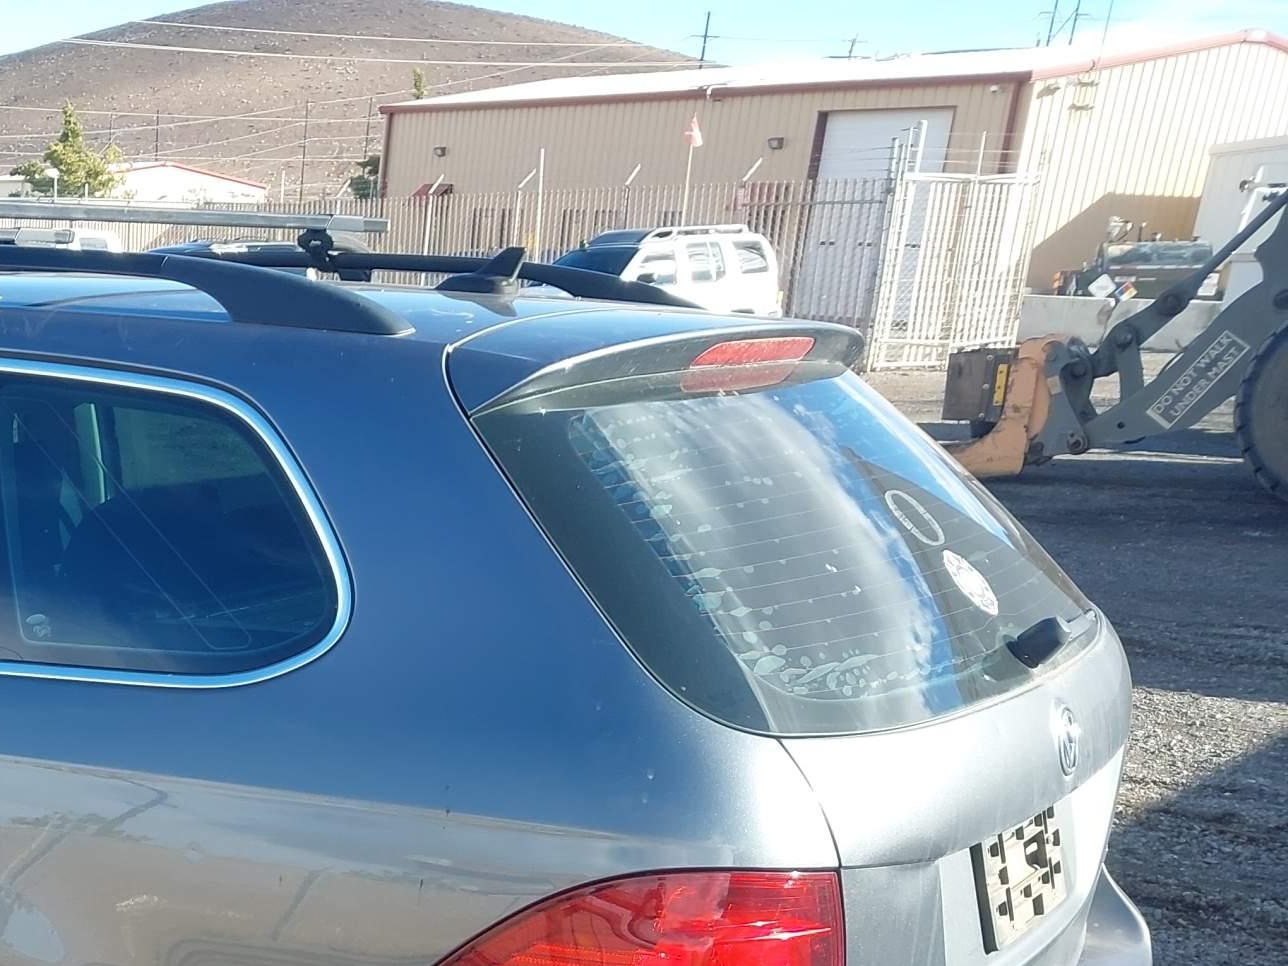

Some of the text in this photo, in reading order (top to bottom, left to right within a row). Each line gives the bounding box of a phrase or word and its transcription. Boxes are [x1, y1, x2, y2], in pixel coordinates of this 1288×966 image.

[1153, 335, 1232, 414] DO NOT WALK
[1169, 346, 1239, 416] UNDER MAST
